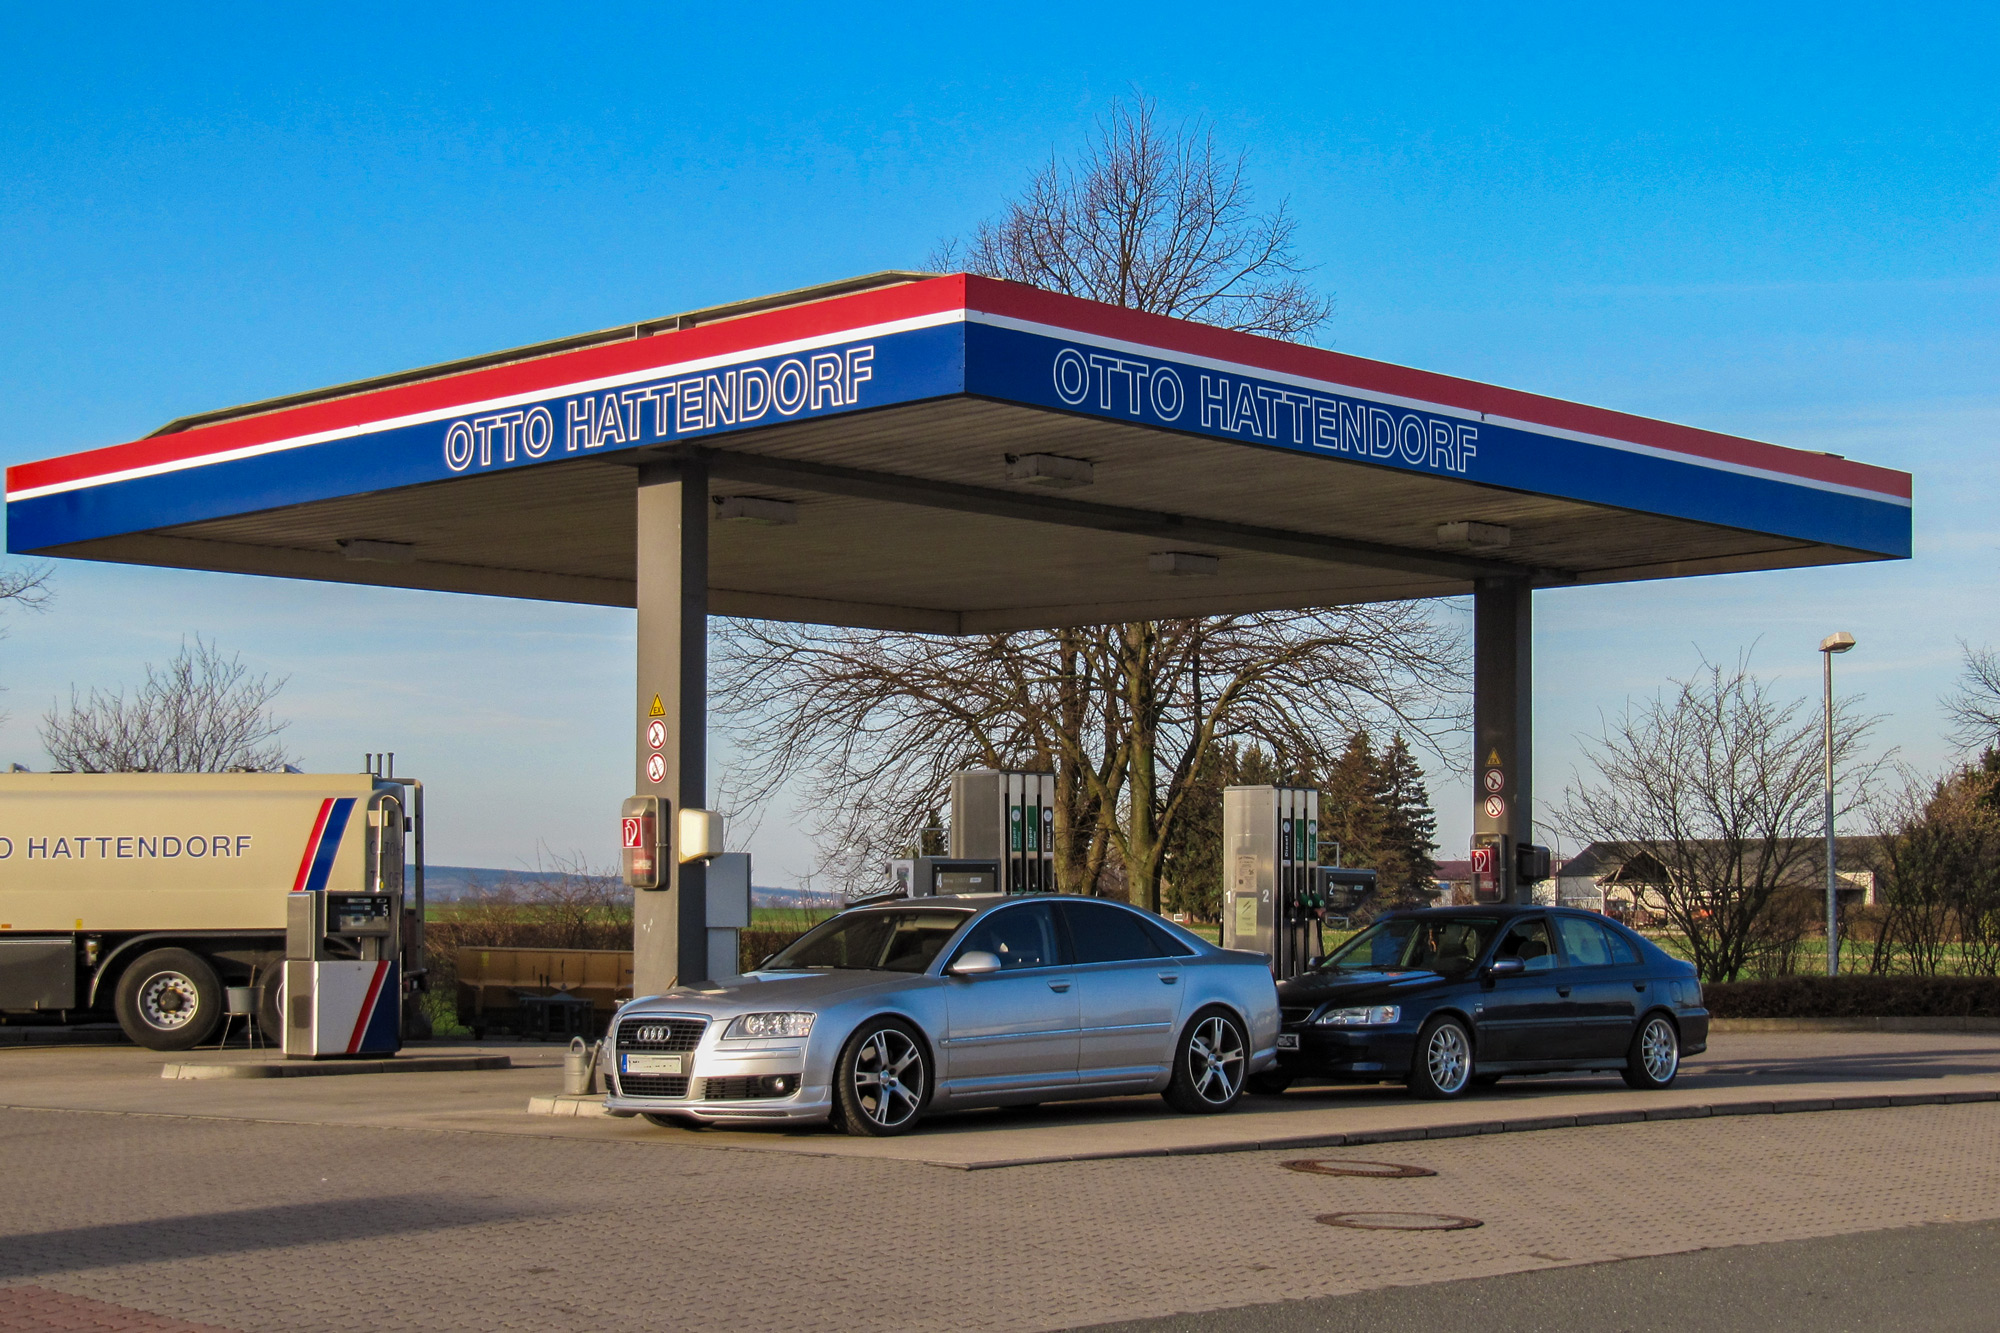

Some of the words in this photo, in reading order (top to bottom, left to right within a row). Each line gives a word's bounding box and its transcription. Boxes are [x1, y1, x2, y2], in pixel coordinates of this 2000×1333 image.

[445, 406, 553, 471] OTTO
[567, 345, 875, 451] HATTENDORF
[1053, 348, 1184, 422] OTTO
[1200, 375, 1478, 473] HATTENDORF
[27, 835, 253, 859] HATTENDORF
[936, 873, 943, 888] 4
[1329, 881, 1334, 895] 2
[1225, 890, 1231, 904] 1
[1262, 889, 1270, 903] 2
[383, 904, 389, 917] 5
